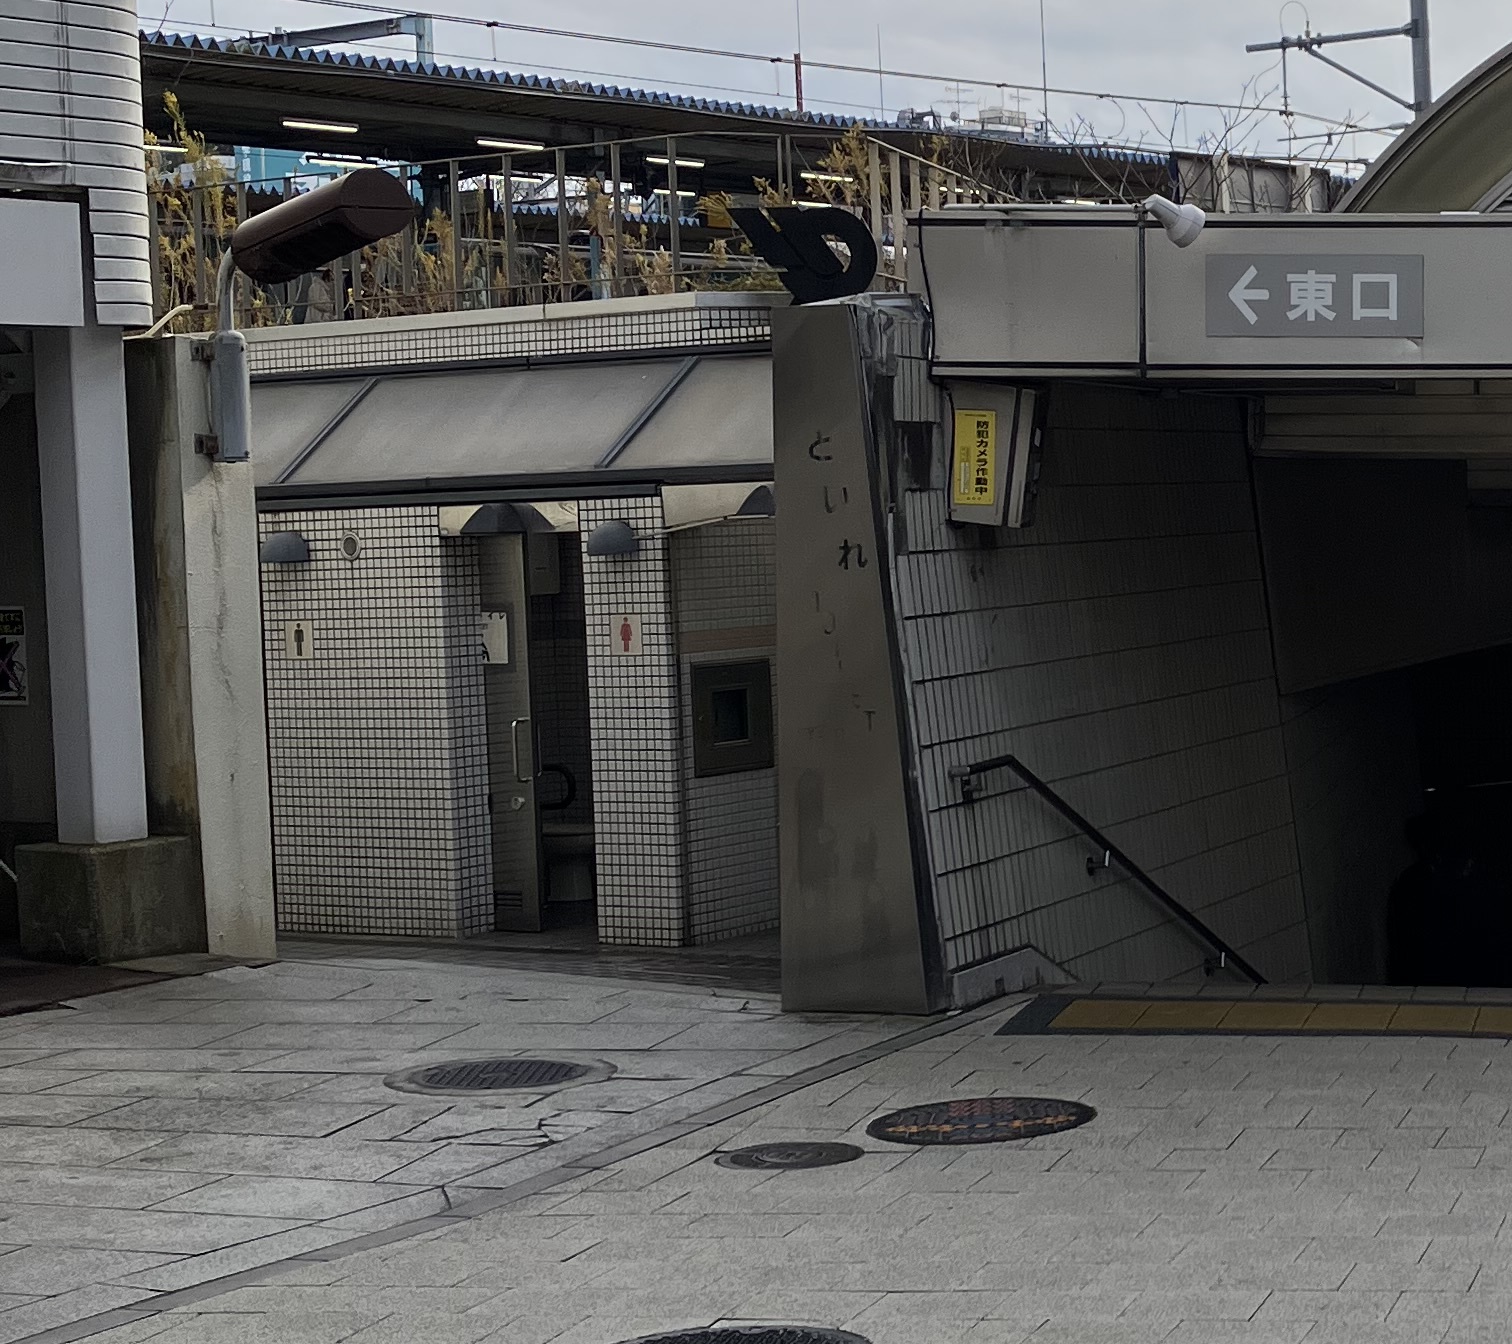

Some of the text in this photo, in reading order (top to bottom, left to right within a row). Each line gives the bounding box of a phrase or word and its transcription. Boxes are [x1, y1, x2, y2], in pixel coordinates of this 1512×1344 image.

[1285, 269, 1398, 322] 東口
[974, 419, 989, 496] 防犯カメラ作動中
